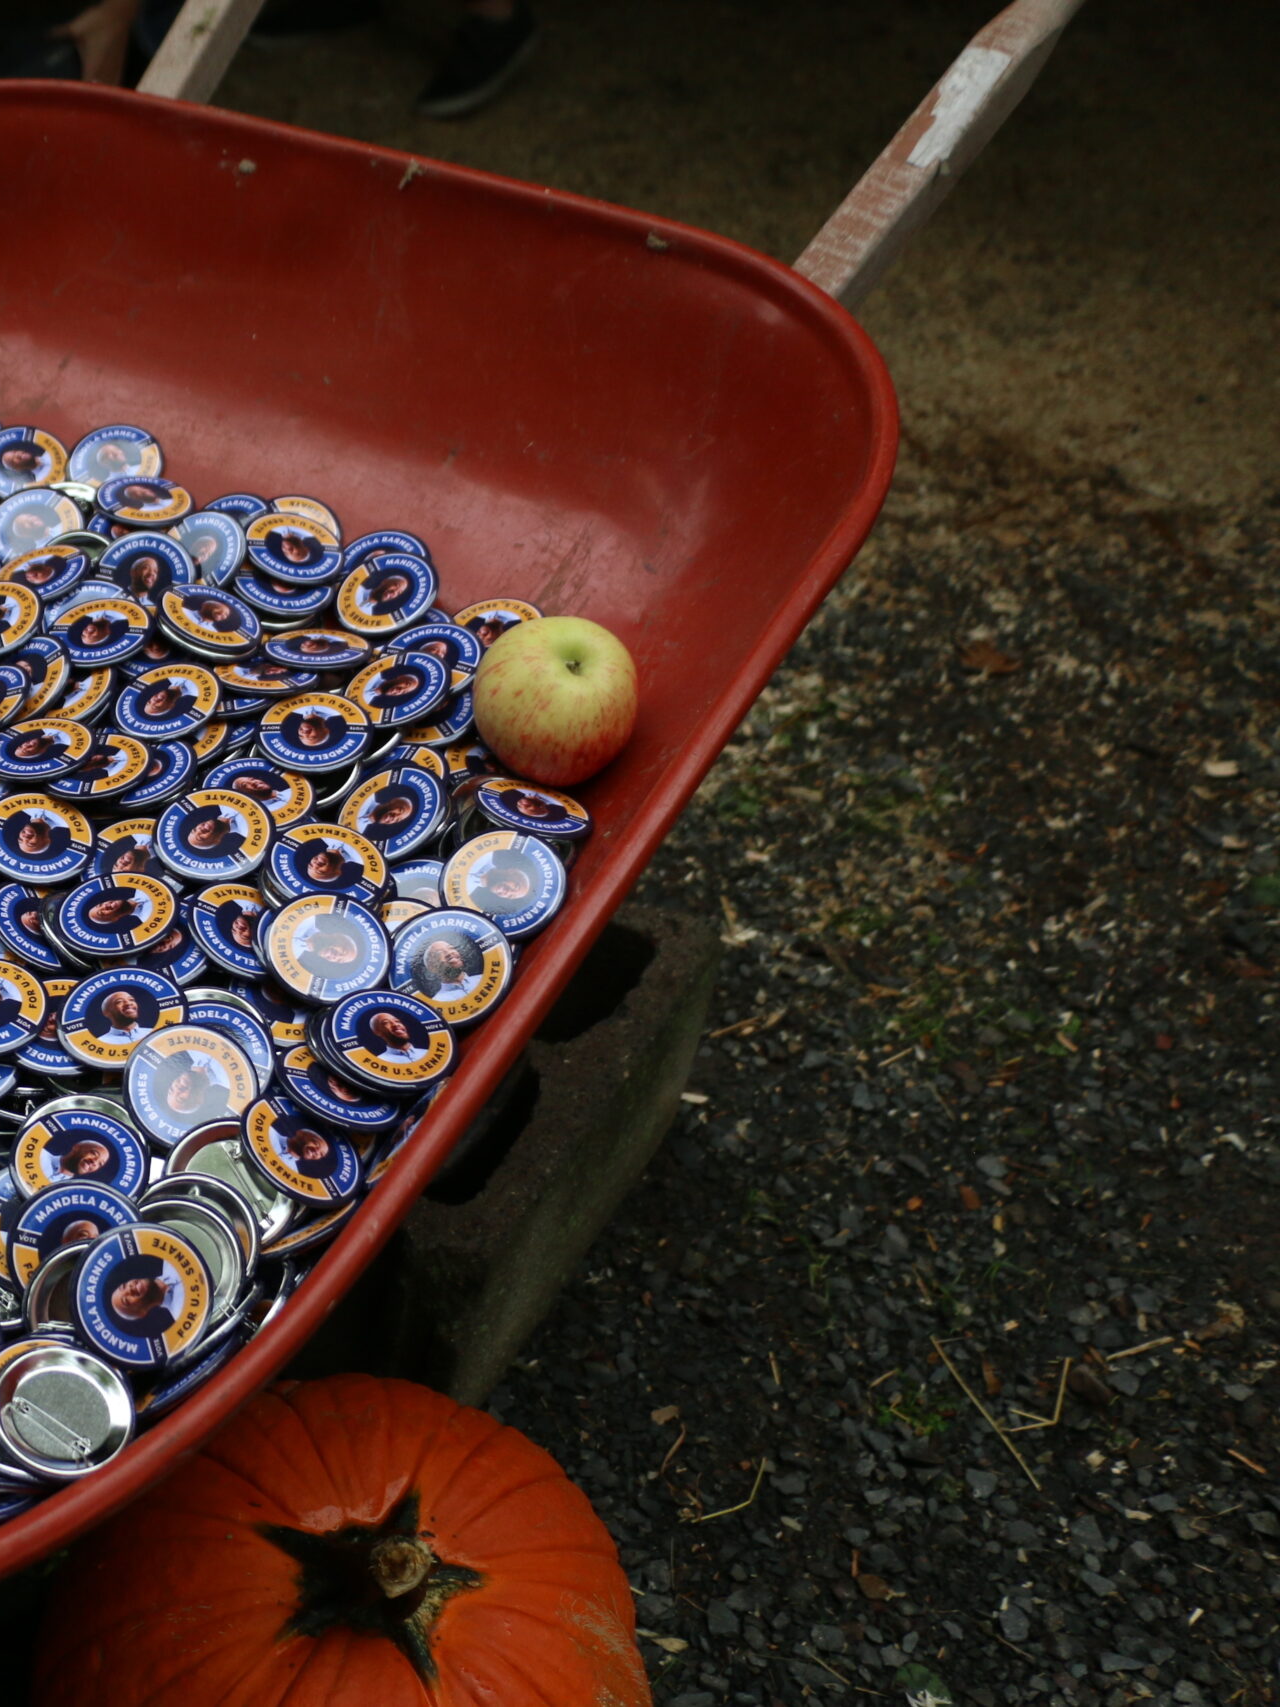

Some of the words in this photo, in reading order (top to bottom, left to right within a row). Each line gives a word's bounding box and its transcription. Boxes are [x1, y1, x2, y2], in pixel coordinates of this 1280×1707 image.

[112, 538, 158, 560] MANDELA
[158, 540, 186, 578] BARNES
[152, 668, 195, 678] SENATE
[202, 684, 212, 701] FOR
[314, 697, 337, 705] U.S.
[122, 695, 137, 724] BARNES
[273, 696, 311, 716] SENATE
[336, 702, 356, 716] FOR
[130, 719, 181, 731] MANDELA
[269, 737, 306, 760] BARNES
[306, 738, 356, 761] MANDELA
[0, 760, 50, 771] MANDELA
[2, 797, 46, 812] SENATE
[48, 801, 70, 814] U.S.
[204, 794, 249, 809] SENATE
[68, 813, 84, 832] FOR
[246, 807, 260, 825] U.S.
[164, 814, 180, 850] BARNES
[250, 827, 262, 847] FOR
[302, 828, 349, 839] SENATE
[349, 836, 370, 852] U.S.
[475, 837, 501, 851] FOR
[17, 855, 73, 871] MANDELA
[171, 848, 224, 869] MANDELA
[366, 853, 378, 872] FOR
[278, 853, 303, 888] BARNES
[533, 849, 554, 900] MANDELA
[126, 877, 164, 897] SENATE
[66, 886, 94, 917] BARNES
[158, 897, 166, 915] U.S.
[294, 901, 319, 915] FOR
[503, 898, 547, 928] BARNES
[66, 917, 108, 944] MANDELA
[143, 916, 164, 933] FOR
[353, 913, 380, 964] MANDELA
[395, 924, 430, 974] MANDELA
[428, 917, 478, 934] BARNES
[275, 935, 300, 979] SENATE
[10, 971, 31, 988] U.S.
[334, 962, 376, 993] BARNES
[447, 1002, 474, 1015] U.S.
[473, 960, 500, 1005] SENATE
[26, 988, 37, 1009] FOR
[71, 974, 117, 1011] MANDELA
[118, 973, 164, 993] BARNES
[14, 1017, 33, 1029] VOTE
[340, 996, 376, 1030] MANDELA
[375, 996, 424, 1016] BARNES
[79, 1039, 104, 1056] FOR
[167, 1034, 219, 1051] SENATE
[340, 1040, 359, 1048] VOTE
[361, 1057, 388, 1074] FOR
[418, 1041, 444, 1073] SENATE
[137, 1073, 162, 1123] BARNES
[253, 1111, 266, 1132] FOR
[22, 1136, 39, 1158] FOR
[71, 1117, 128, 1146] MANDELA
[116, 1144, 135, 1188] BARNES
[255, 1133, 270, 1157] U.S.
[335, 1144, 351, 1183] BARNES
[266, 1158, 314, 1191] SENATE
[125, 1238, 135, 1255] NOV
[151, 1238, 196, 1277] SENATE
[85, 1250, 114, 1304] BARNES
[190, 1279, 199, 1308] U.S.
[86, 1305, 137, 1354] MANDELA
[175, 1310, 198, 1339] FOR
[152, 1336, 164, 1358] VOTE
